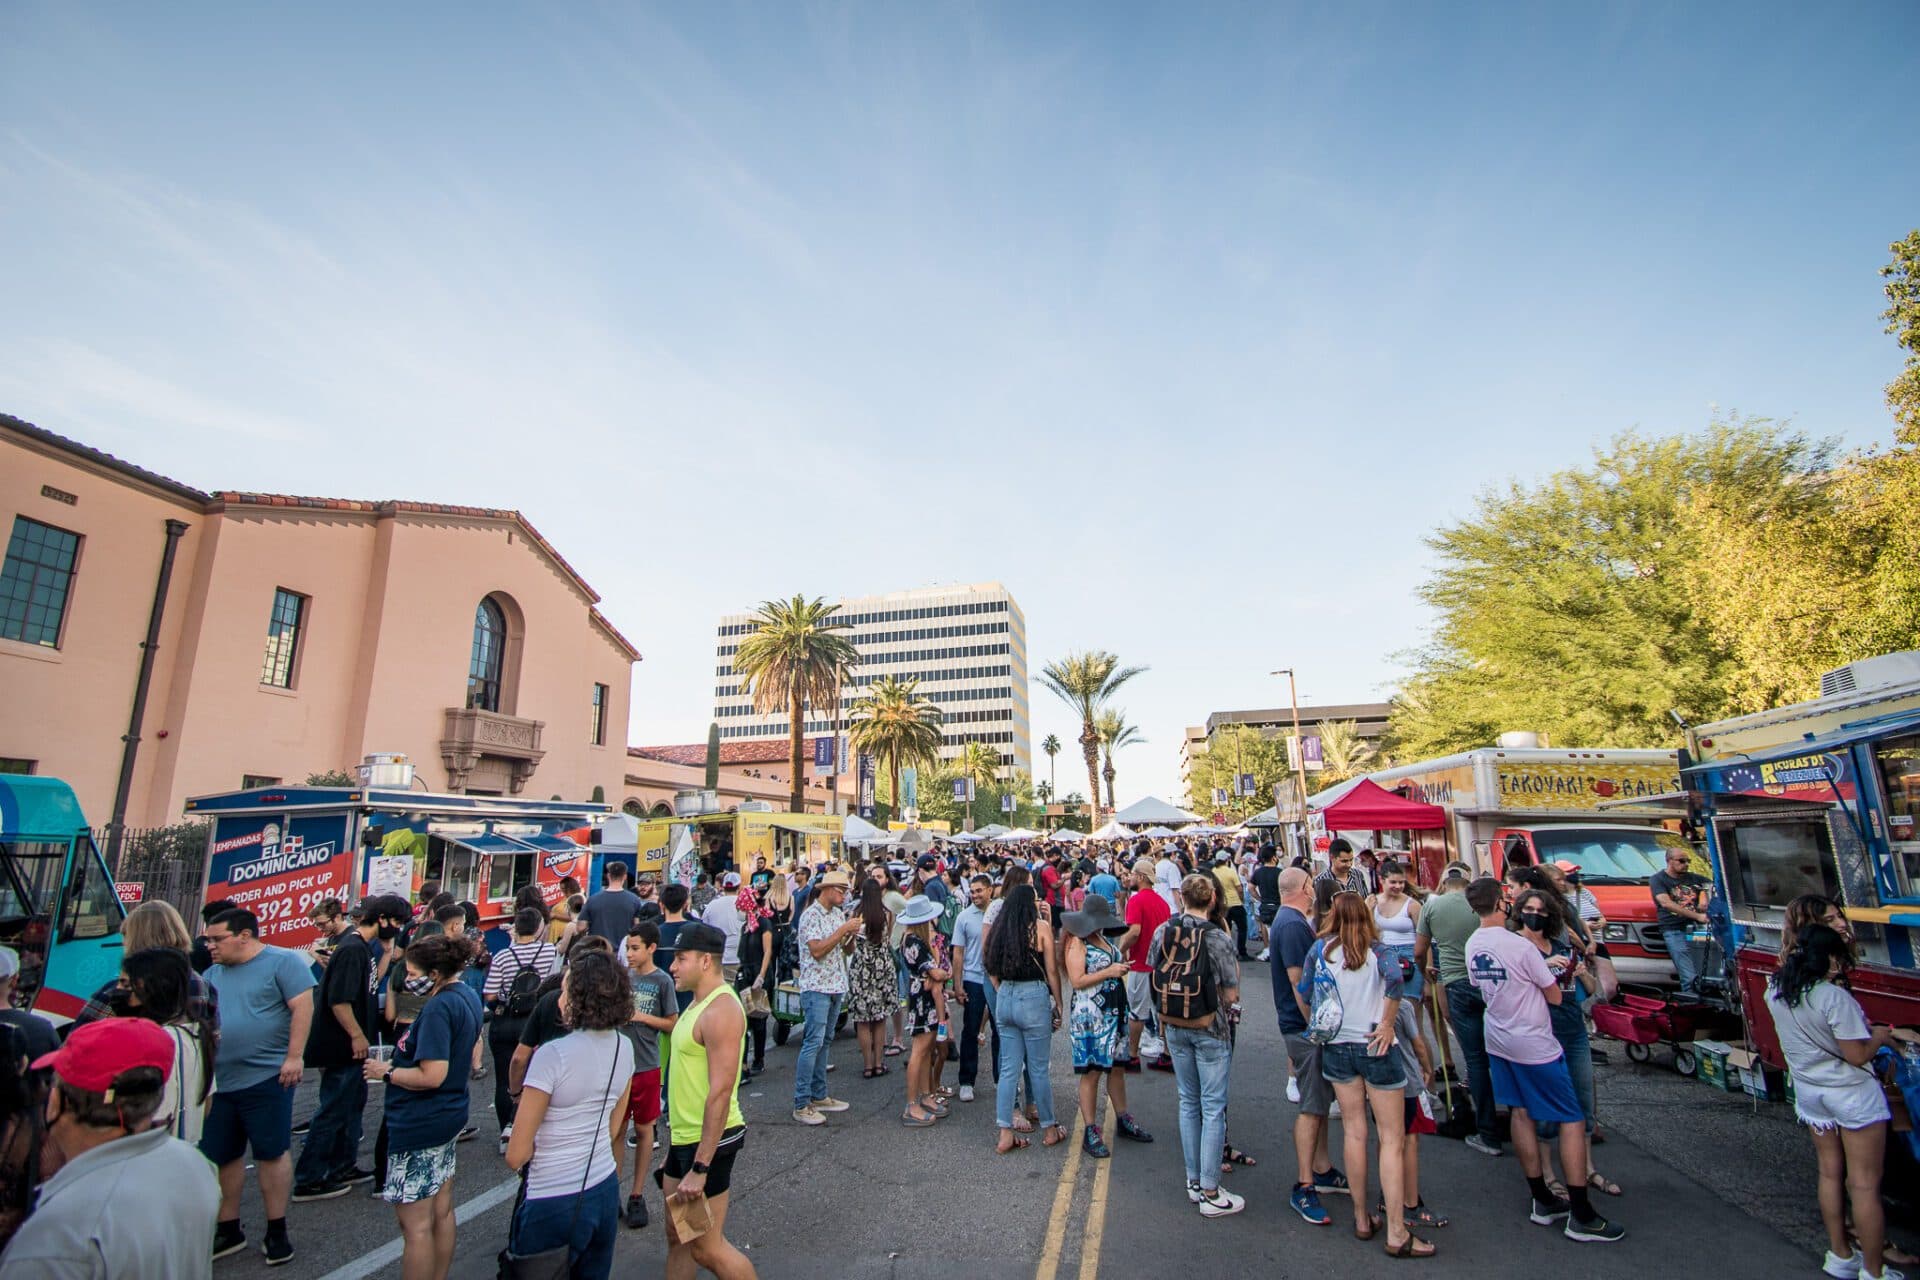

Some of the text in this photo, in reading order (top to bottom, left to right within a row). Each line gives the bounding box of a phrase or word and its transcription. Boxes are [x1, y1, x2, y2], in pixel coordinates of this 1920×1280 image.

[1500, 774, 1583, 794] TAKOYAKI
[216, 833, 262, 852] EMPANADAS
[261, 845, 280, 860] EL
[233, 847, 329, 883] DOMINICANO
[116, 884, 142, 892] SOUTH
[264, 883, 287, 896] AND
[289, 876, 314, 892] PICK
[317, 872, 333, 885] UP
[120, 892, 136, 900] FDC
[257, 897, 293, 922] 392
[271, 924, 279, 935] Y
